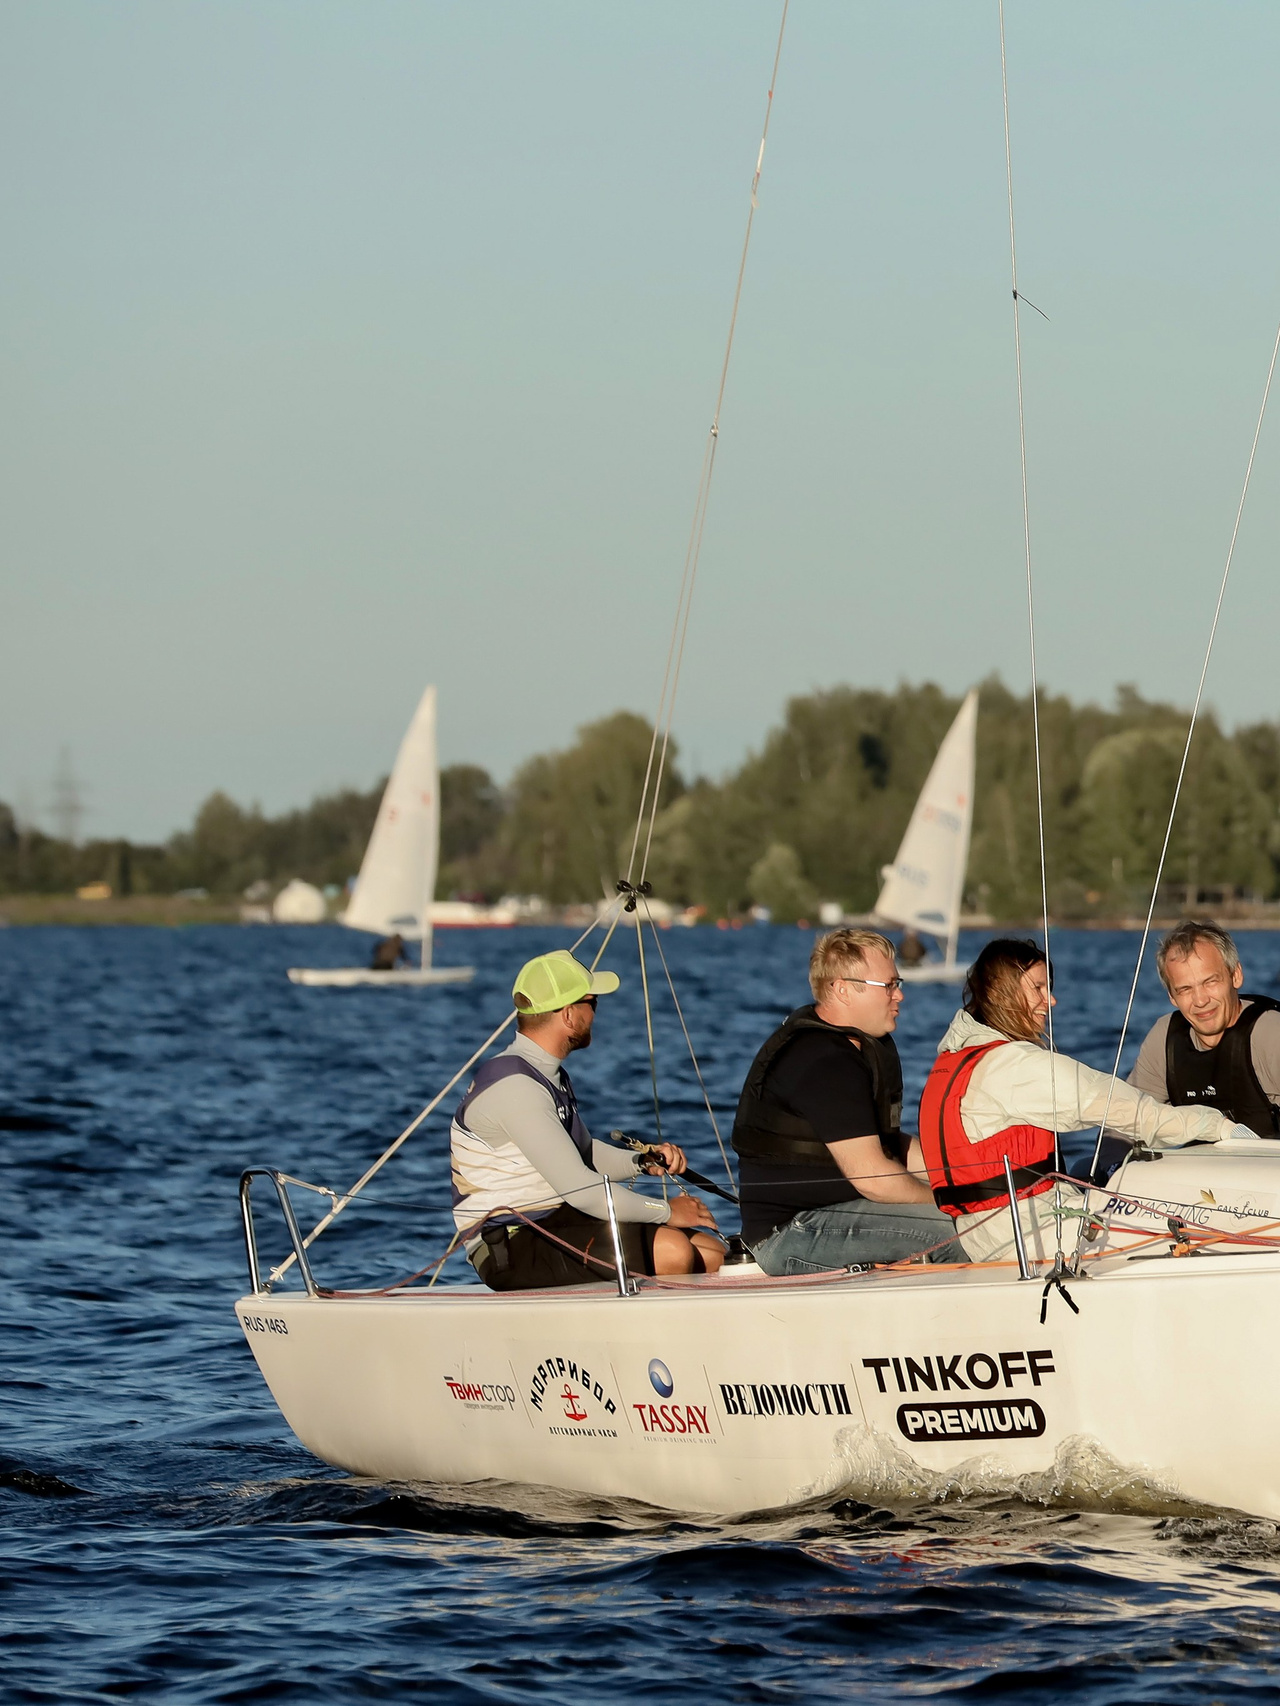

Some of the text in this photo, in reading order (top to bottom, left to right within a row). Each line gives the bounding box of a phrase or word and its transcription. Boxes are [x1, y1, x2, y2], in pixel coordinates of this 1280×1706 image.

[243, 1315, 289, 1334] RUS 1463
[530, 1357, 617, 1415] МОРПРИБОР
[862, 1350, 1055, 1393] TINKOFF
[719, 1382, 852, 1419] ВЕДОМОСТИ
[632, 1404, 711, 1434] TASSAY
[904, 1405, 1038, 1435] PREMIUM
